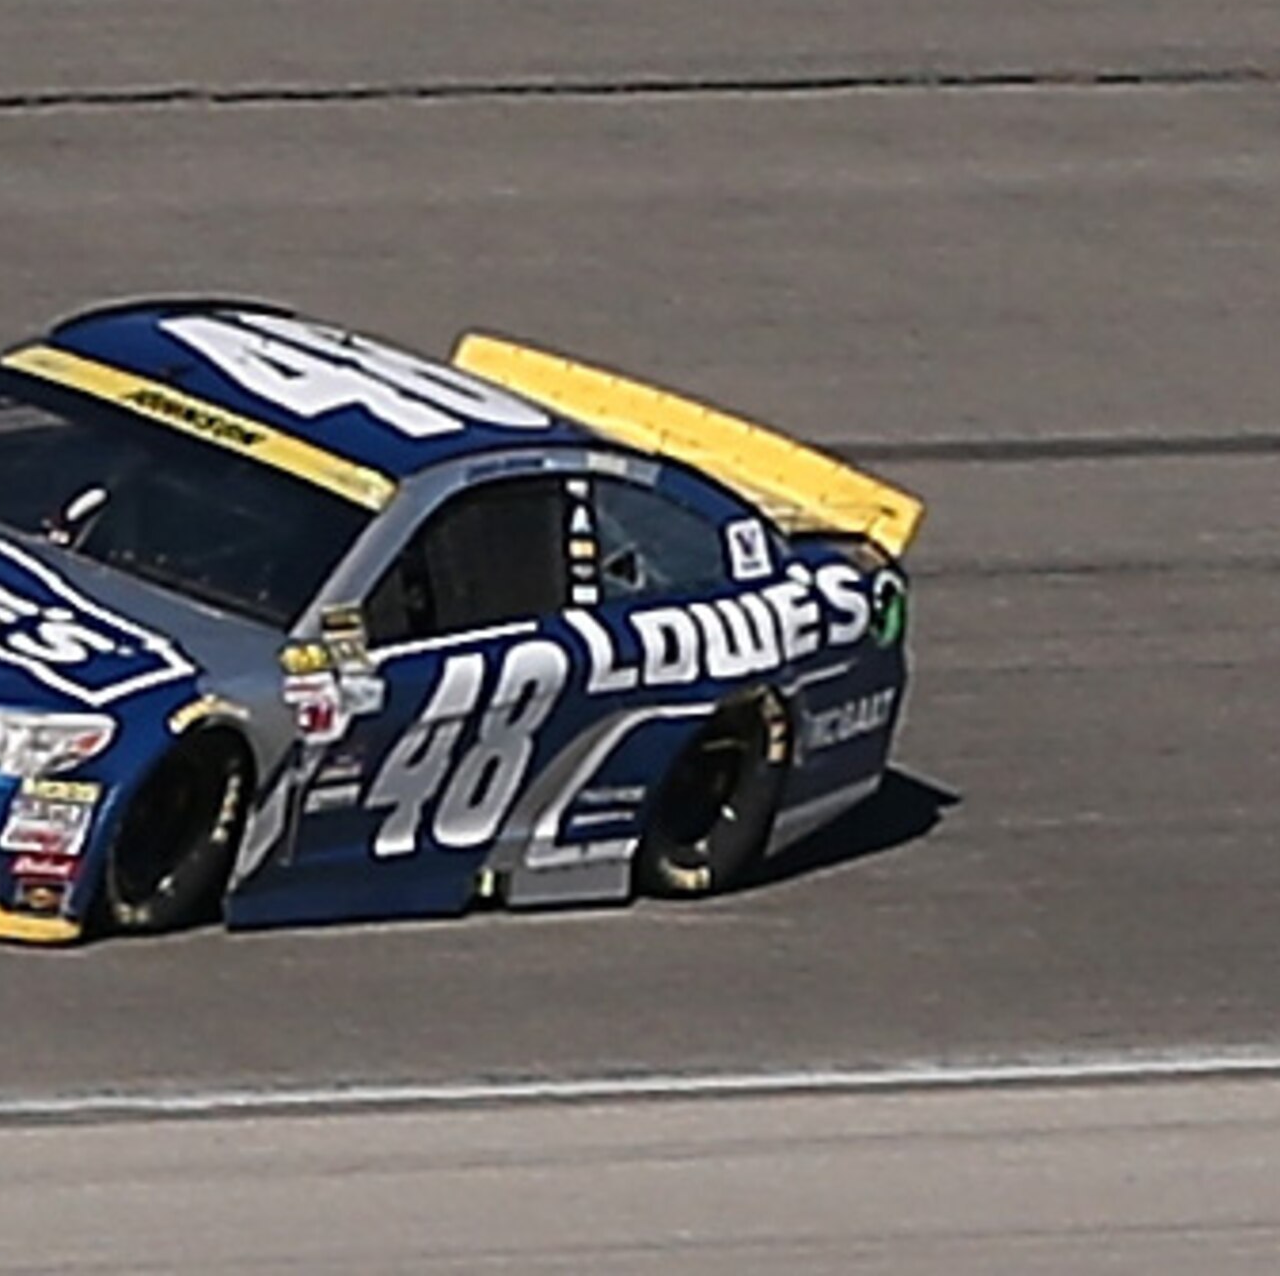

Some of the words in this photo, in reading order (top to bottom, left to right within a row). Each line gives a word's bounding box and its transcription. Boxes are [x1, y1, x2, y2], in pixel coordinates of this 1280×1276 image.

[157, 311, 551, 437] 48
[563, 564, 871, 694] LOWE'S
[365, 640, 569, 856] 48
